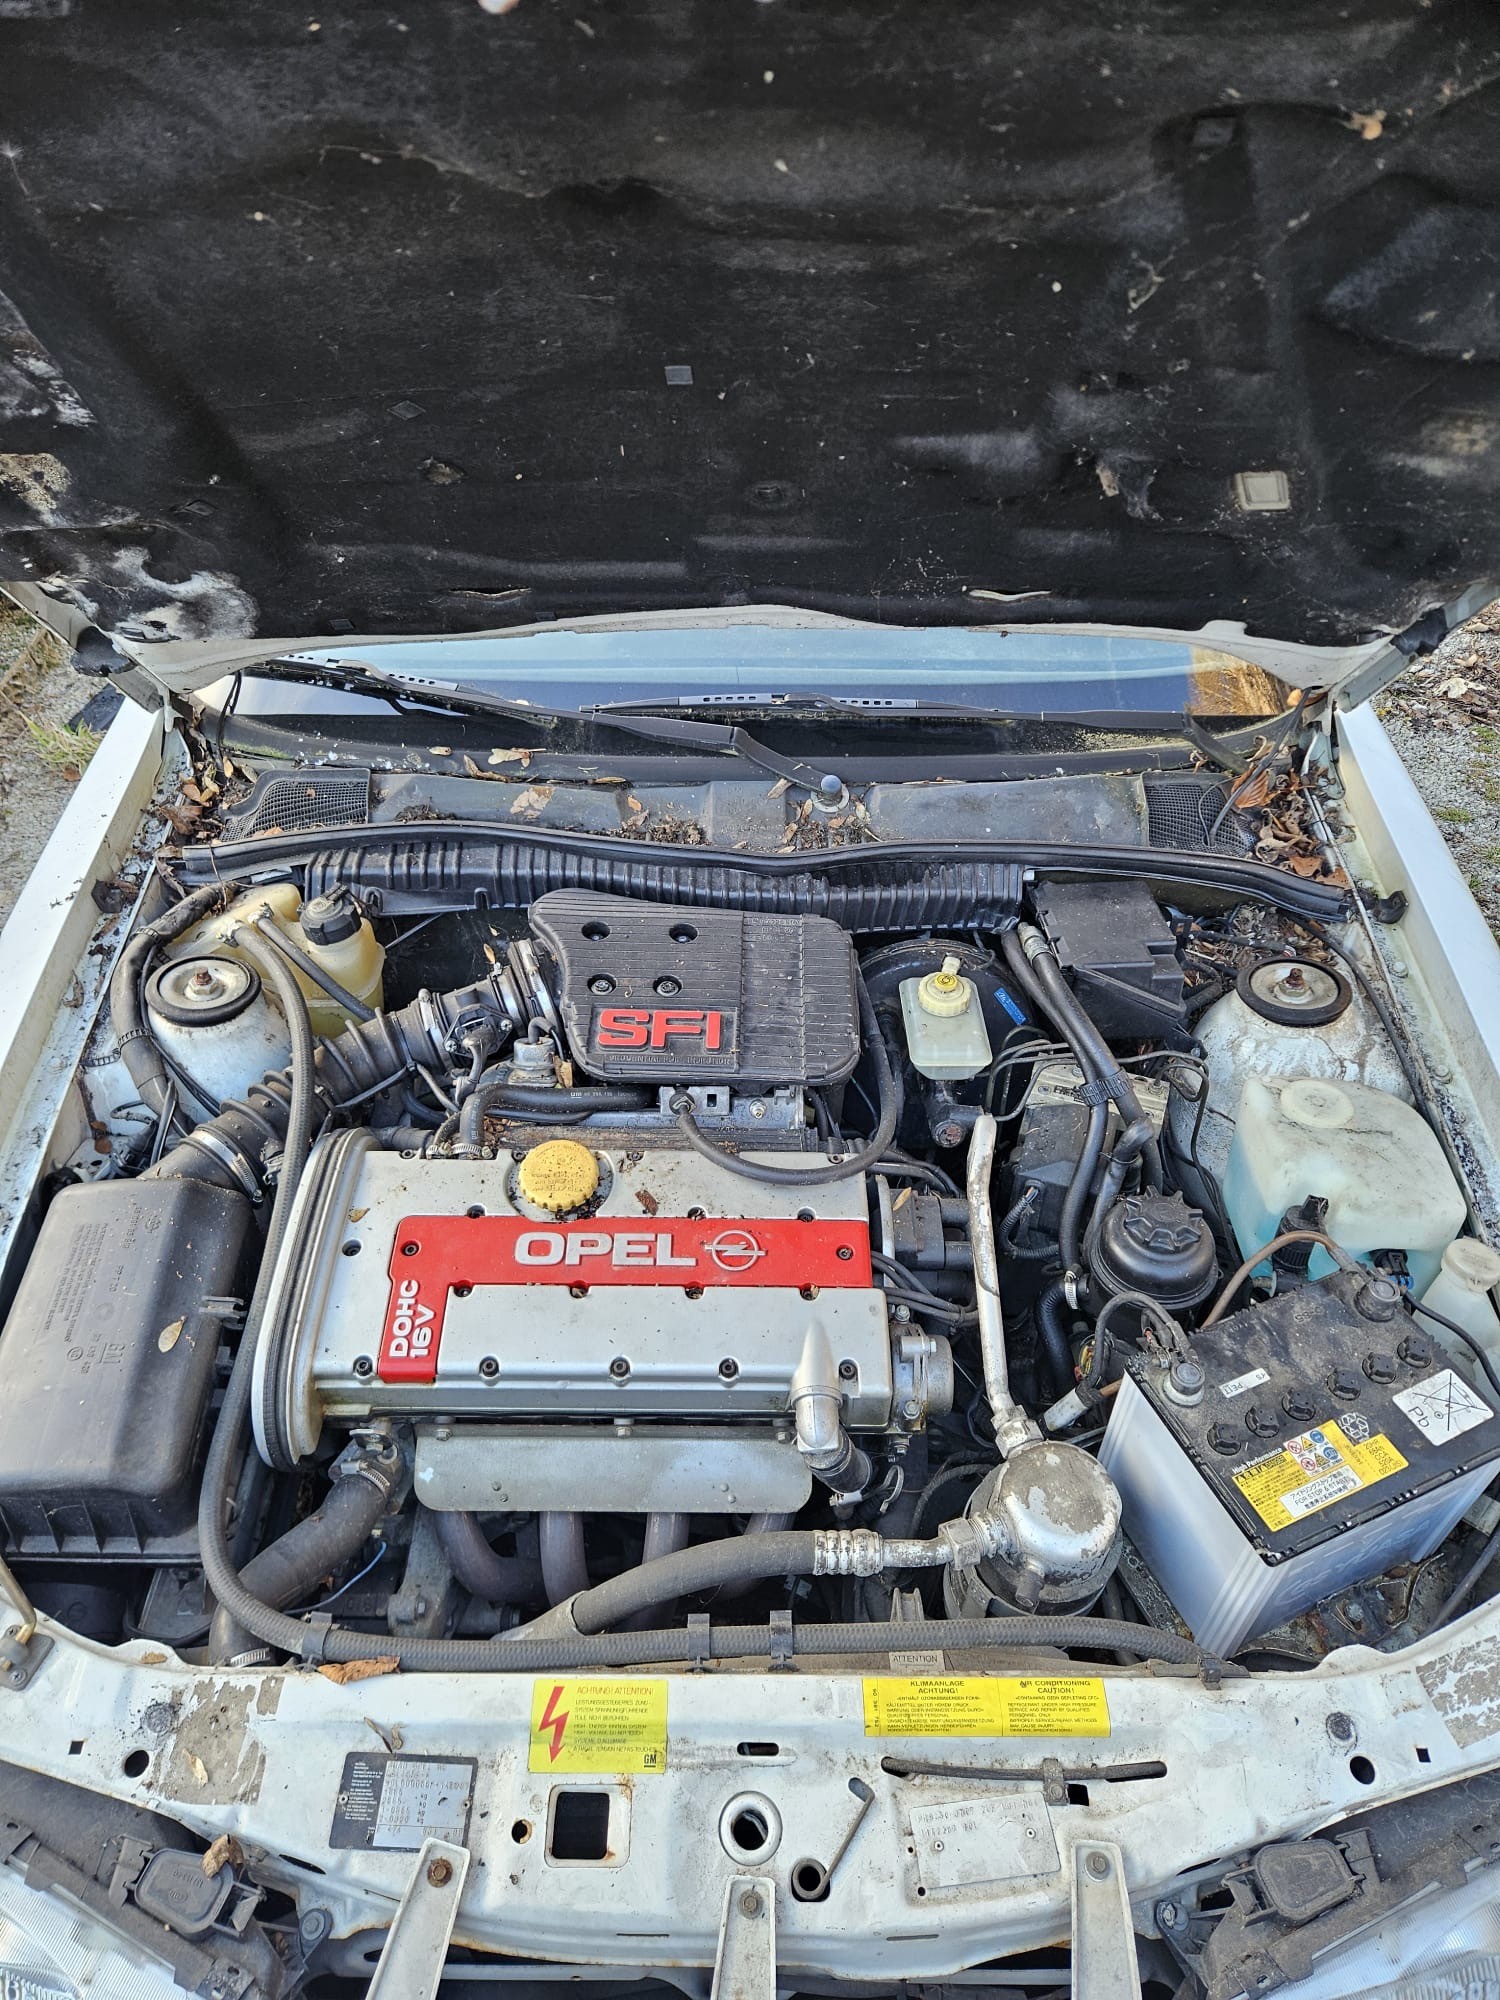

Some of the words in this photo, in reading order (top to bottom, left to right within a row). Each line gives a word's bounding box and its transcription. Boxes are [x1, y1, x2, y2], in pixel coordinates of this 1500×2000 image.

[597, 1009, 721, 1049] SFI
[515, 1232, 697, 1267] OPEL
[390, 1279, 419, 1358] DOHC
[410, 1304, 436, 1359] 16V
[1407, 1406, 1430, 1427] Pb
[1231, 1462, 1247, 1474] High
[1248, 1447, 1282, 1468] Performance
[1294, 1495, 1308, 1506] FOR
[1307, 1488, 1324, 1502] STOP
[893, 1655, 938, 1663] ATTENTION
[644, 1754, 657, 1764] GM
